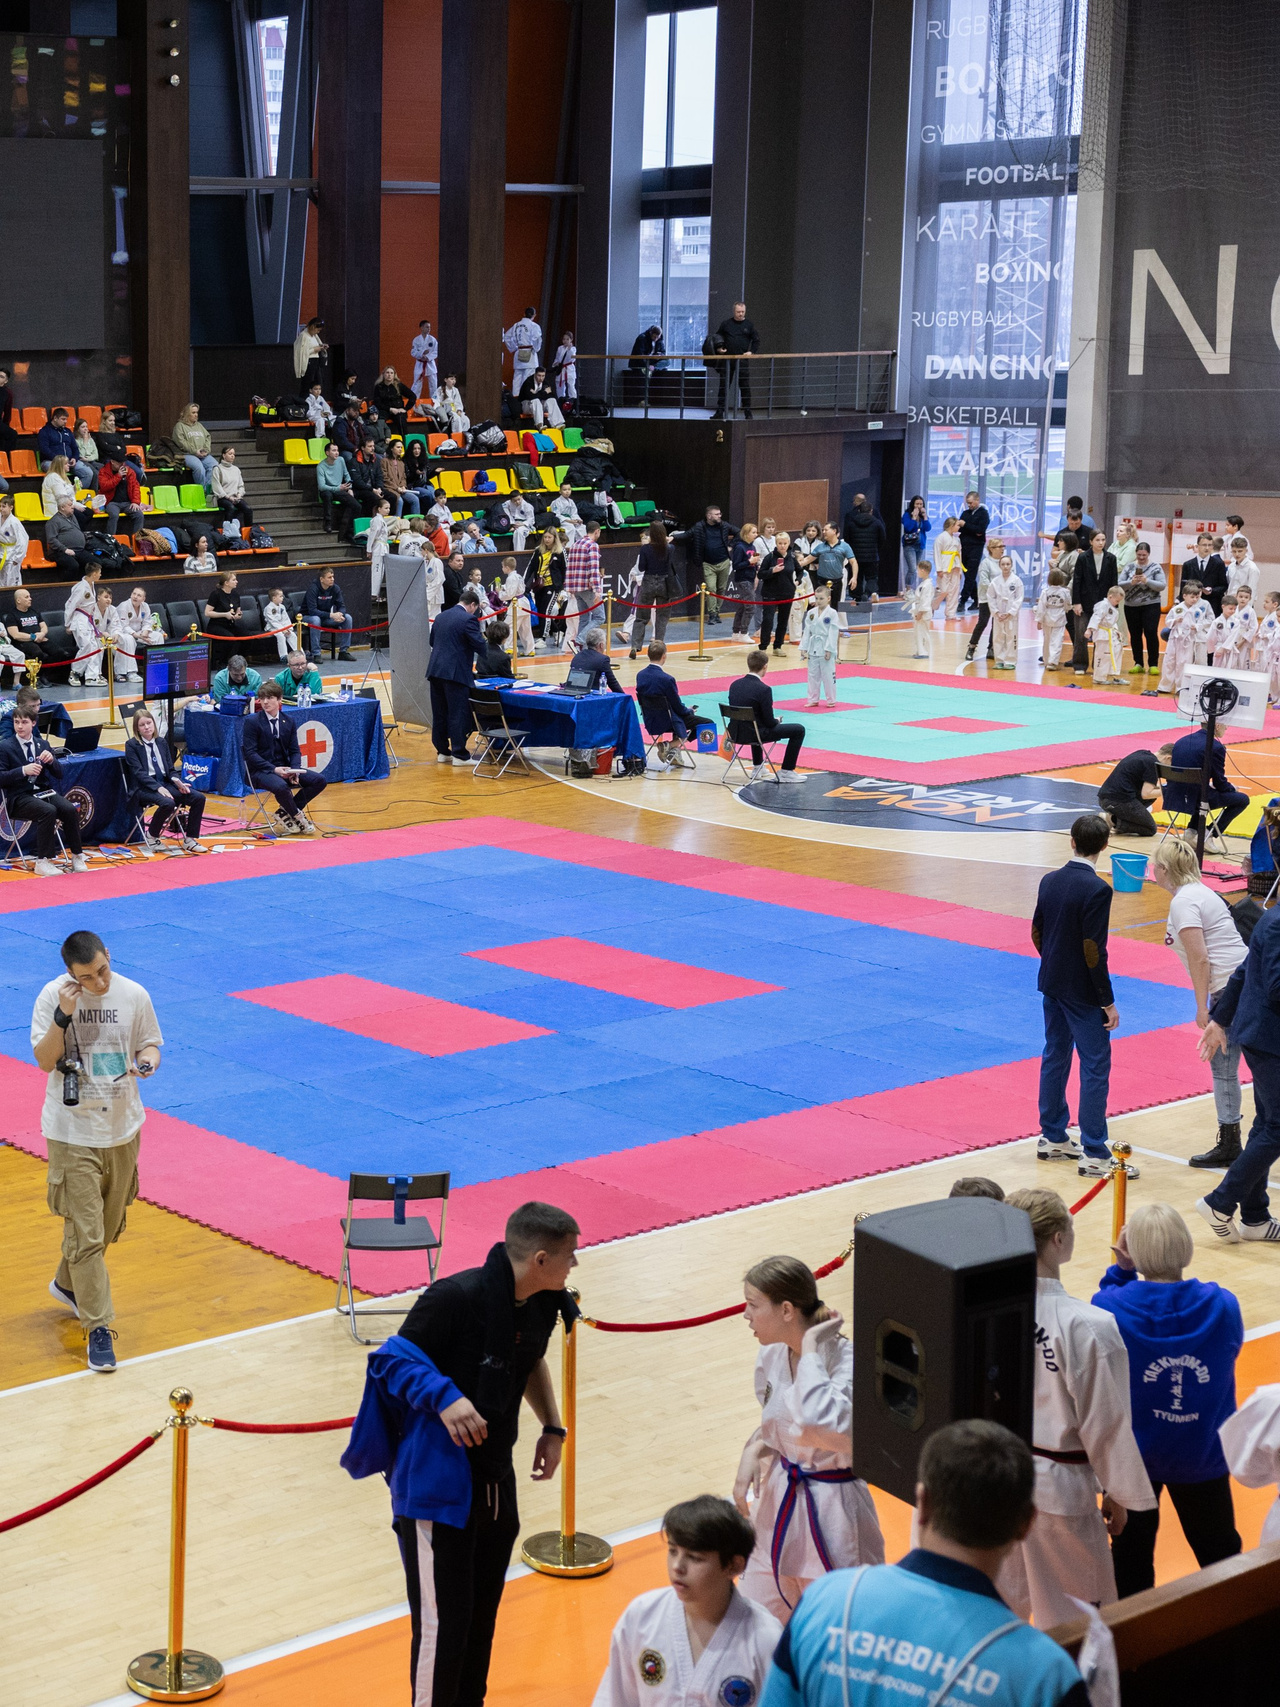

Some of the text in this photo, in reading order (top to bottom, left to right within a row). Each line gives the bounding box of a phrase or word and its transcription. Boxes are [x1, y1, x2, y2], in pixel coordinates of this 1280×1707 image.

[916, 210, 1040, 242] KARATE
[1128, 244, 1280, 376] N
[183, 761, 209, 774] Reebok
[823, 786, 1027, 824] NOVA
[79, 1008, 119, 1024] NATURE
[1142, 1354, 1211, 1384] TAEKWON-DO
[1152, 1409, 1200, 1424] TYUMEN
